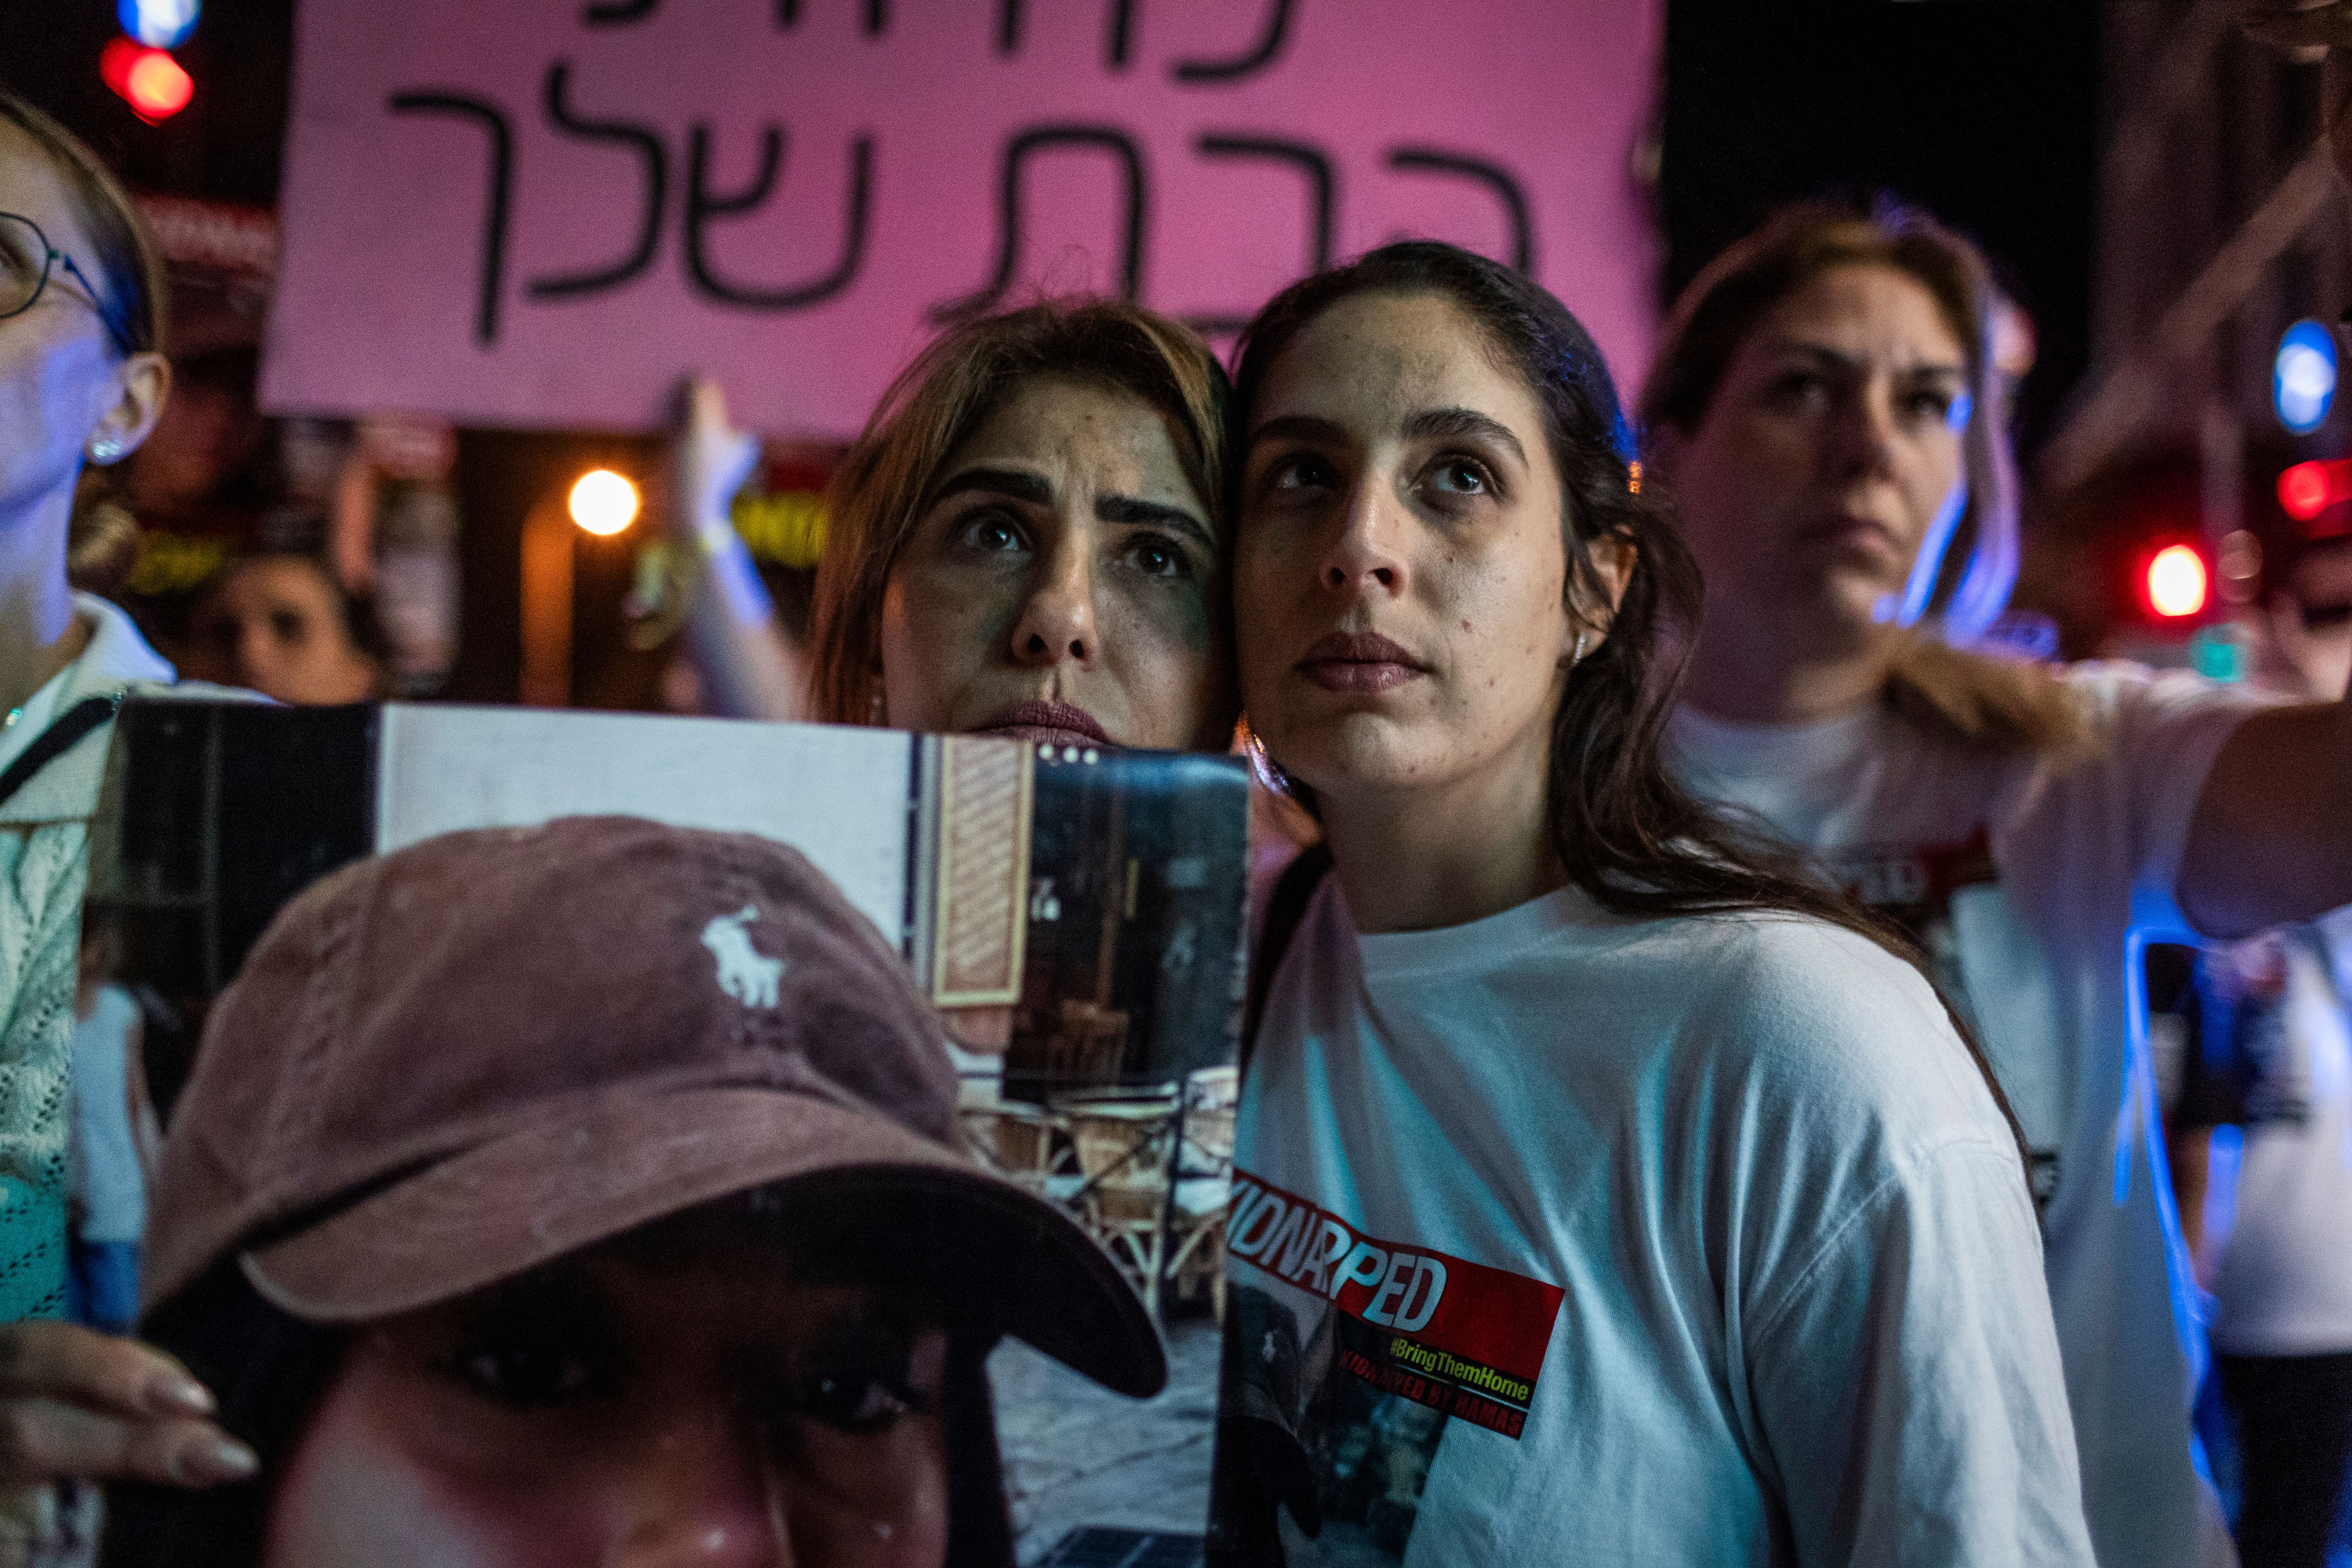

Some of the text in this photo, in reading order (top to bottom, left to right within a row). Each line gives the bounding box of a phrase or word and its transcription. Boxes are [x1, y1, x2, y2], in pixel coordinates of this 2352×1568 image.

[387, 60, 878, 347] שלך
[1226, 1179, 1448, 1332] IDNAPPED
[1390, 1338, 1530, 1401] #BringThemHome
[1454, 1392, 1523, 1436] HAMAS
